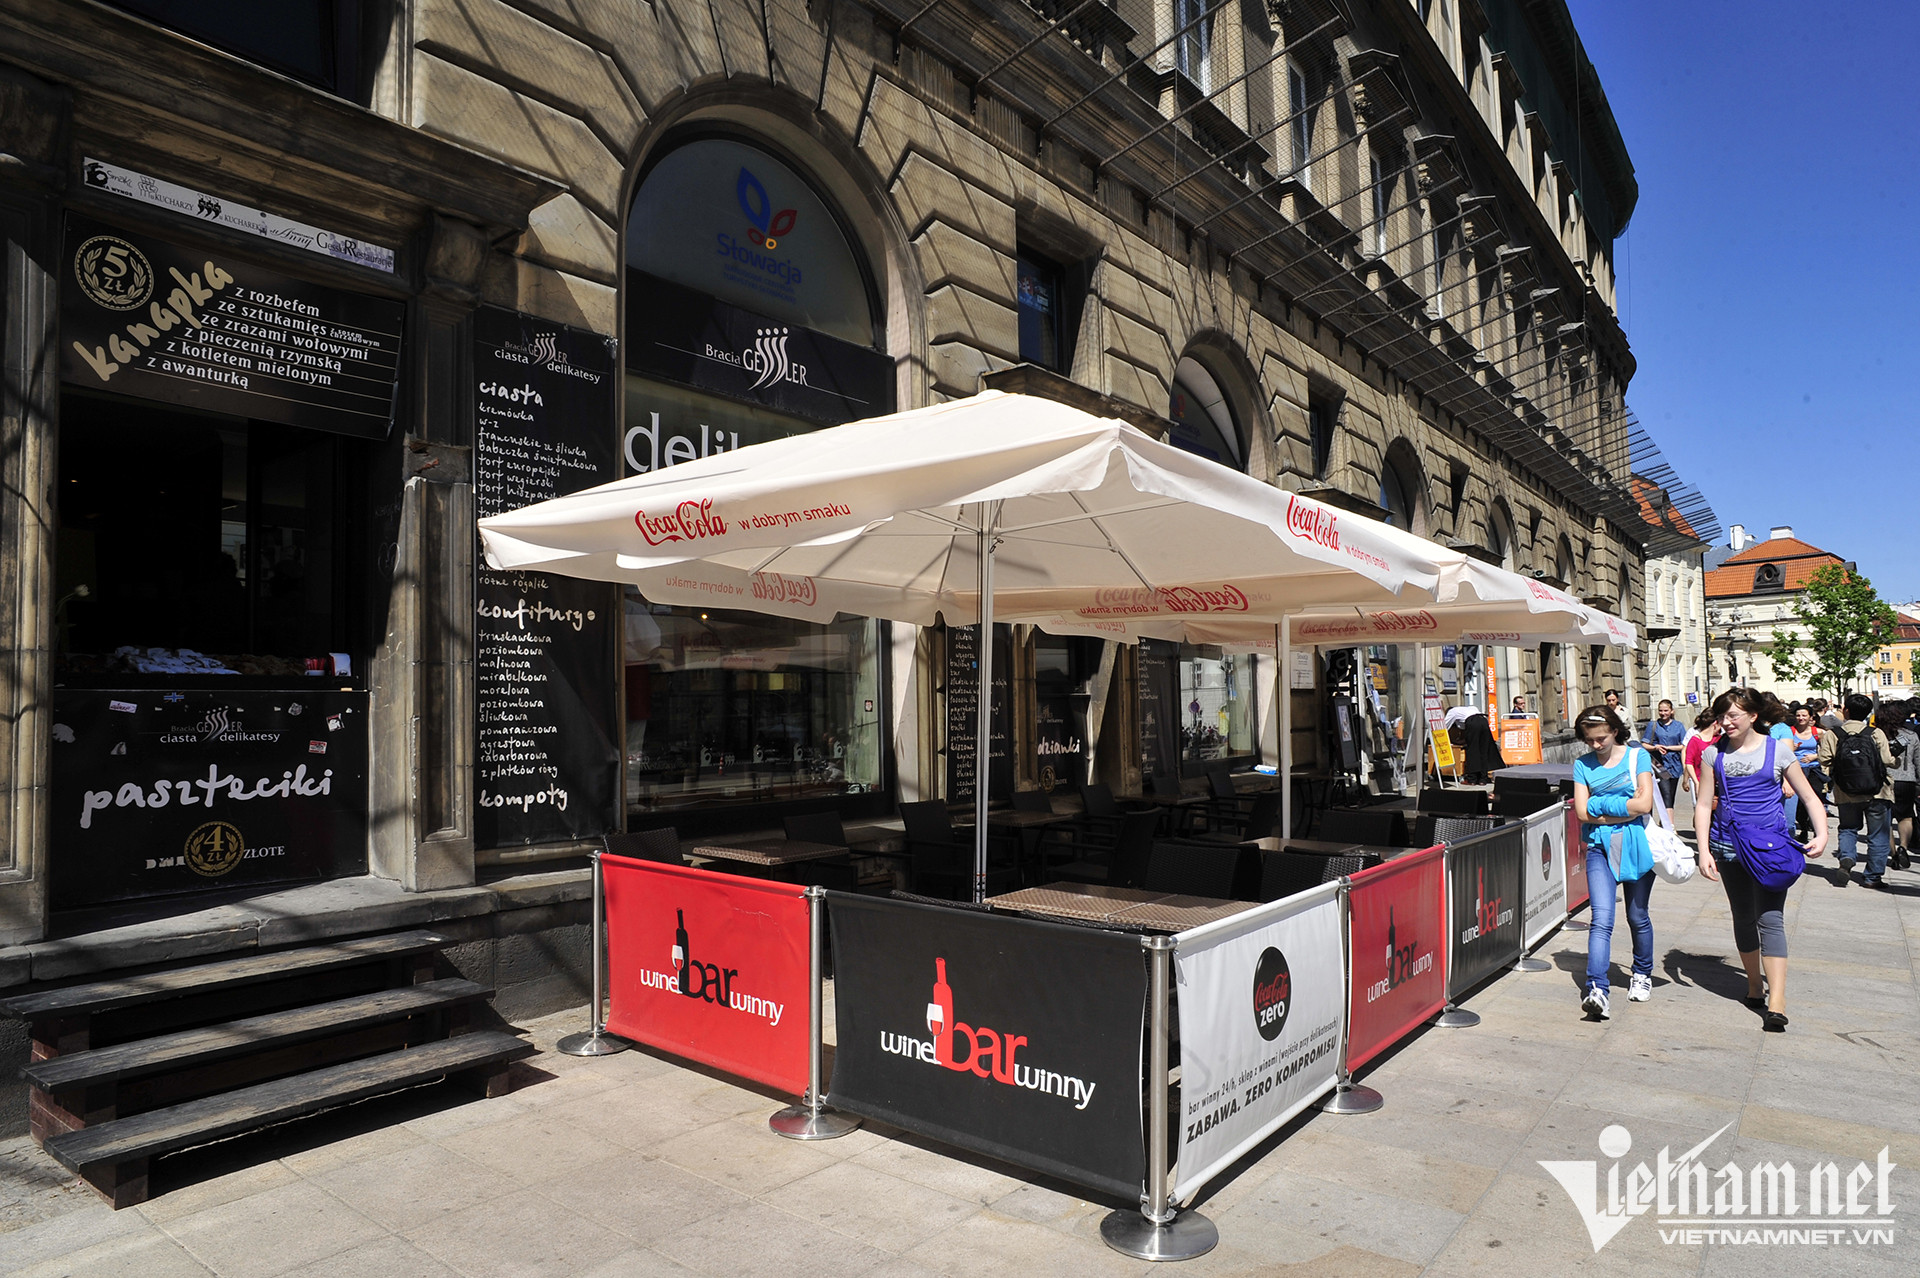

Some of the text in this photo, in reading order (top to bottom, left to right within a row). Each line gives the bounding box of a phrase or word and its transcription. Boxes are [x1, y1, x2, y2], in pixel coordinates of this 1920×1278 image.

[154, 194, 194, 211] KUCHARZY
[102, 245, 130, 278] 5
[717, 233, 802, 284] Słowacja
[235, 286, 321, 317] z rozbefem
[73, 260, 235, 382] kanapka
[218, 300, 327, 336] ze sztukamięs
[201, 313, 369, 360] ze zrazami wołowymi
[338, 329, 363, 339] sosem
[184, 326, 343, 373] z pieczenią rzymską
[705, 344, 742, 365] Bracia
[147, 356, 250, 389] z awanturką
[166, 341, 332, 386] z kotletem mielonym
[494, 349, 601, 385] ciasta delikatesy
[479, 381, 544, 407] ciasta
[479, 403, 535, 422] kremówka
[478, 427, 542, 448] francuskie
[478, 440, 530, 460] babeczka
[478, 453, 561, 479] tort europejski
[478, 467, 504, 480] tort
[478, 480, 504, 494] tort
[478, 493, 504, 507] tort
[738, 518, 750, 532] w
[752, 510, 803, 529] dobrym
[803, 502, 853, 521] smaku
[479, 574, 509, 587] różne
[477, 598, 584, 632] konfitury
[478, 629, 553, 644] truskawkowa
[479, 645, 543, 659] poziomkowa
[479, 656, 531, 669] malinowa
[479, 669, 548, 683] mirabelkowa
[1487, 666, 1495, 694] kantor
[479, 683, 530, 696] morelowa
[479, 698, 544, 713] poziomkowa
[160, 732, 281, 745] ciasta delikatesy
[480, 736, 536, 755] agrestowa
[480, 749, 548, 763] rabarbarowa
[481, 769, 488, 778] z
[80, 763, 333, 829] paszteciki
[479, 782, 568, 813] kompoty
[203, 825, 224, 852] 4
[243, 846, 286, 860] ZŁOTE
[1367, 977, 1391, 1003] wine
[1388, 925, 1418, 990] bar
[640, 928, 784, 1027] wine bar winny
[1260, 1000, 1286, 1028] zero
[880, 983, 1097, 1110] wine bar winny
[1188, 1101, 1200, 1115] bar
[1201, 1091, 1220, 1107] winny
[1238, 1070, 1254, 1086] sklep
[1259, 1052, 1278, 1072] winami
[1299, 1035, 1309, 1052] przy
[1186, 1035, 1338, 1145] ZABAWA. ZERO KOMPROMISU
